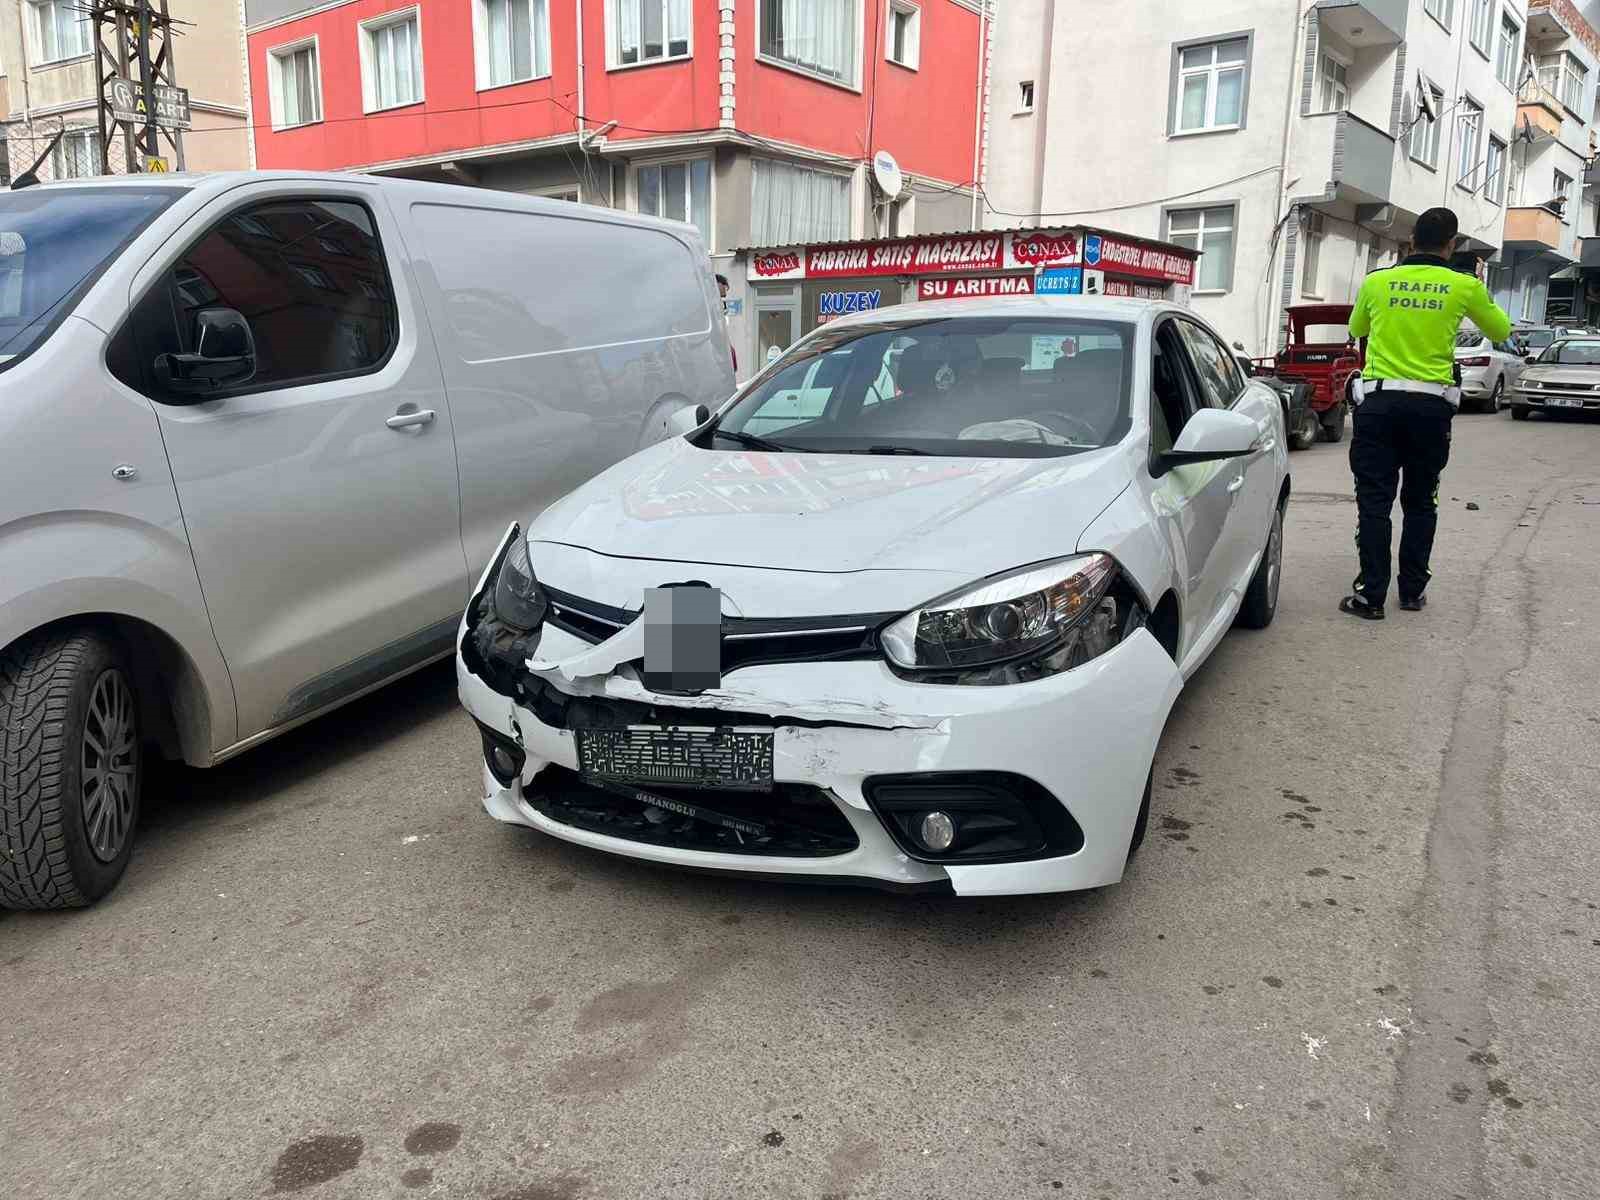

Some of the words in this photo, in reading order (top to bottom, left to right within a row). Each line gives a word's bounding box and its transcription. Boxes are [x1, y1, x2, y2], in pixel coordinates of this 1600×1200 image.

[136, 98, 186, 118] AART
[809, 247, 868, 272] FABRİKA
[871, 244, 914, 269] SATIŞ
[914, 238, 1000, 266] MAĞAZASI
[1017, 241, 1073, 257] CONAX
[758, 256, 796, 271] CONAX
[922, 280, 948, 295] SU
[953, 277, 1031, 294] ARITMA
[820, 289, 881, 314] KUZEY
